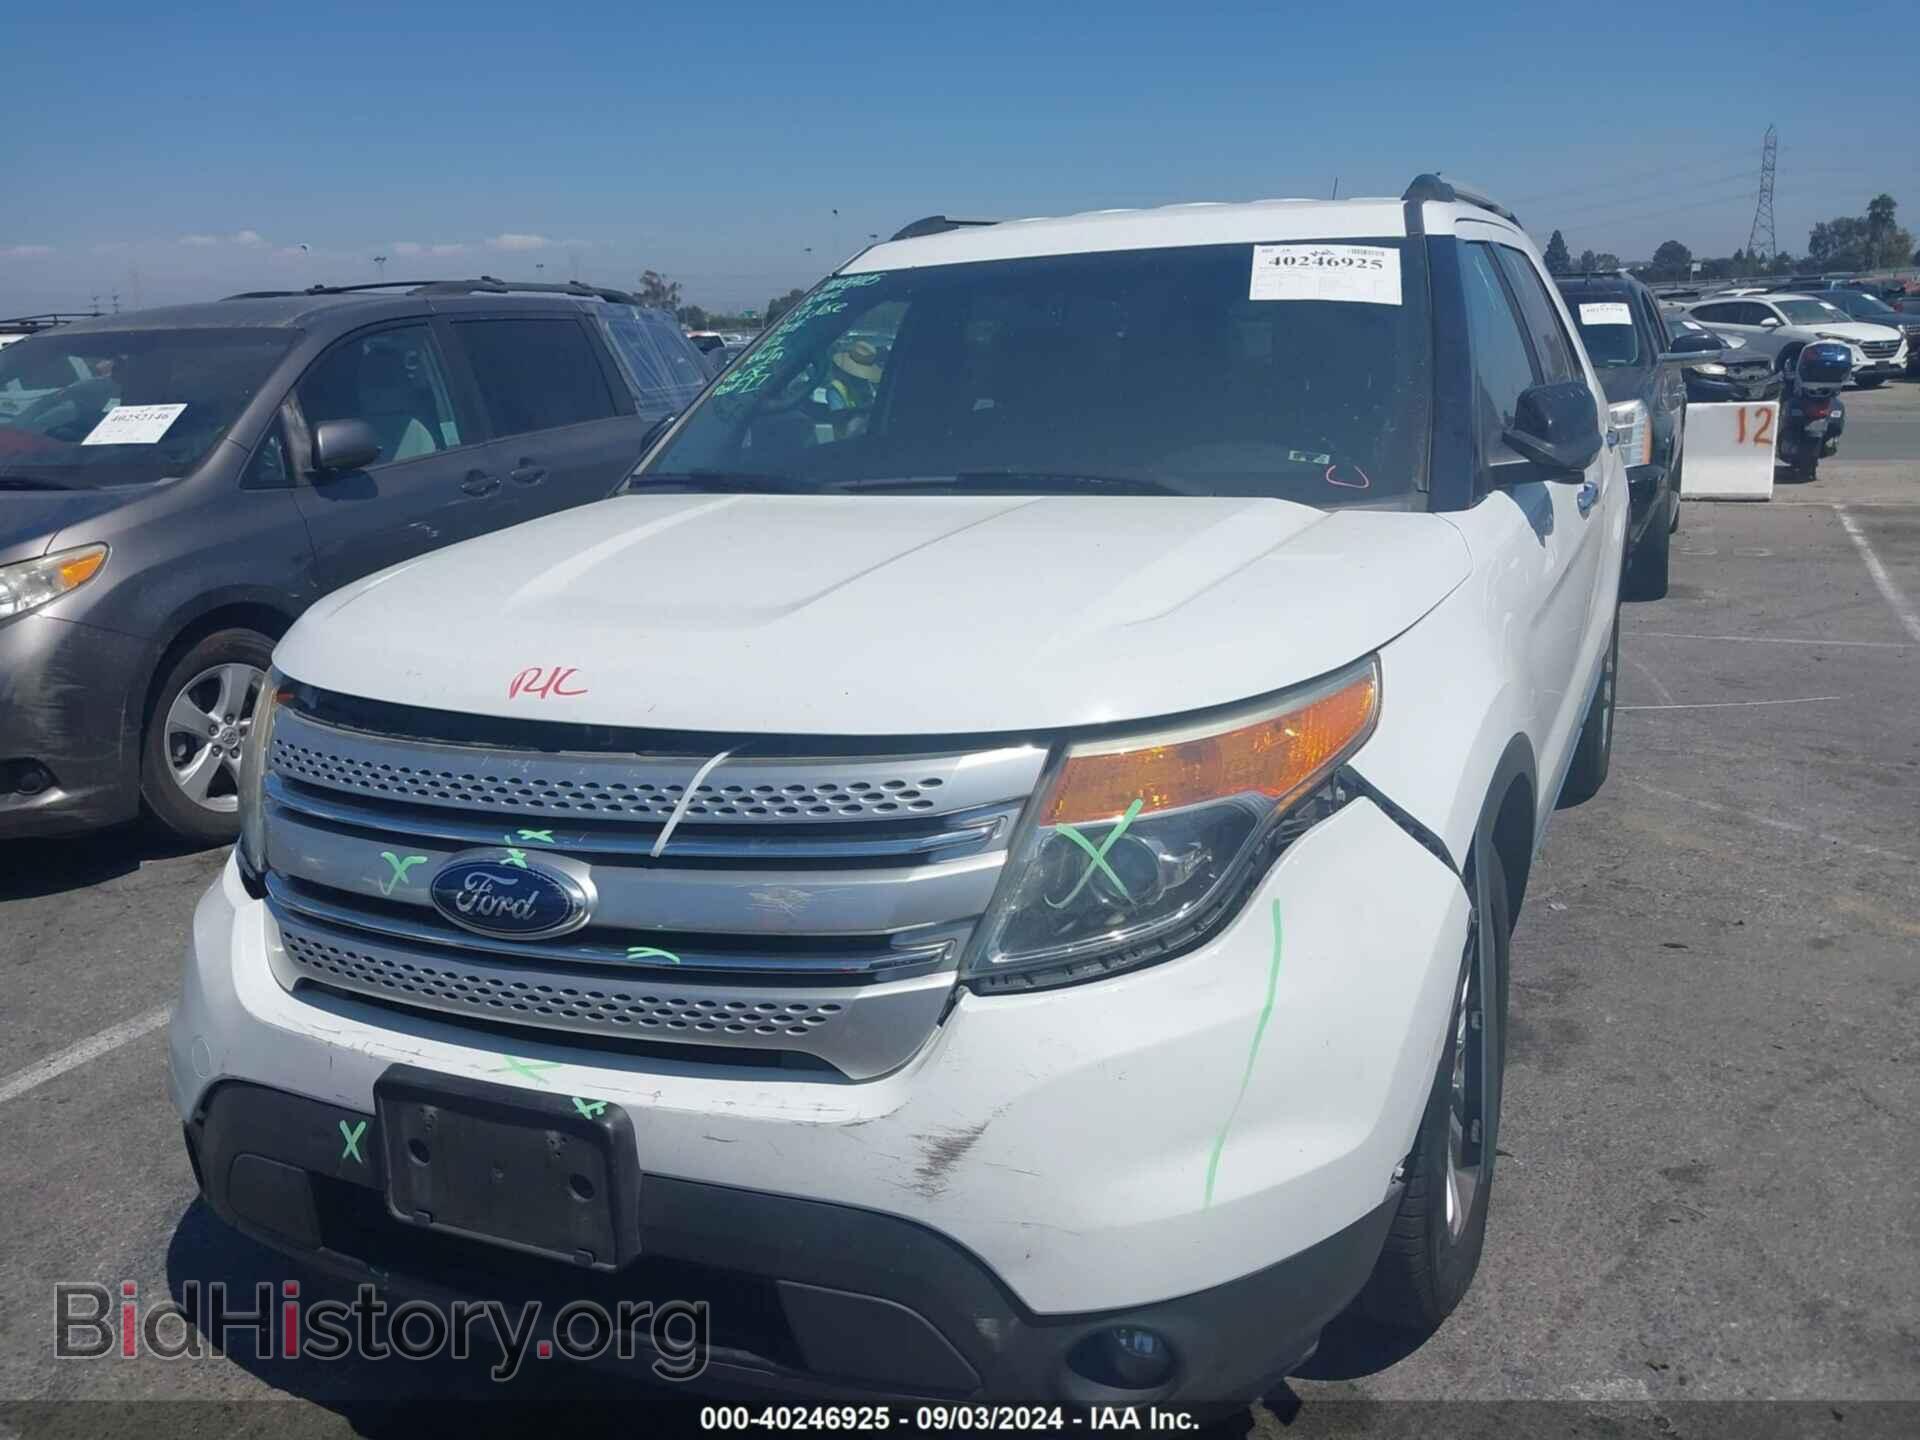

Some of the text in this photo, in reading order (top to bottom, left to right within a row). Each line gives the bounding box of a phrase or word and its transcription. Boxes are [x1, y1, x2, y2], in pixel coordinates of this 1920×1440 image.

[1268, 256, 1384, 270] 40246925
[1735, 406, 1775, 446] 12
[455, 871, 541, 921] Ford
